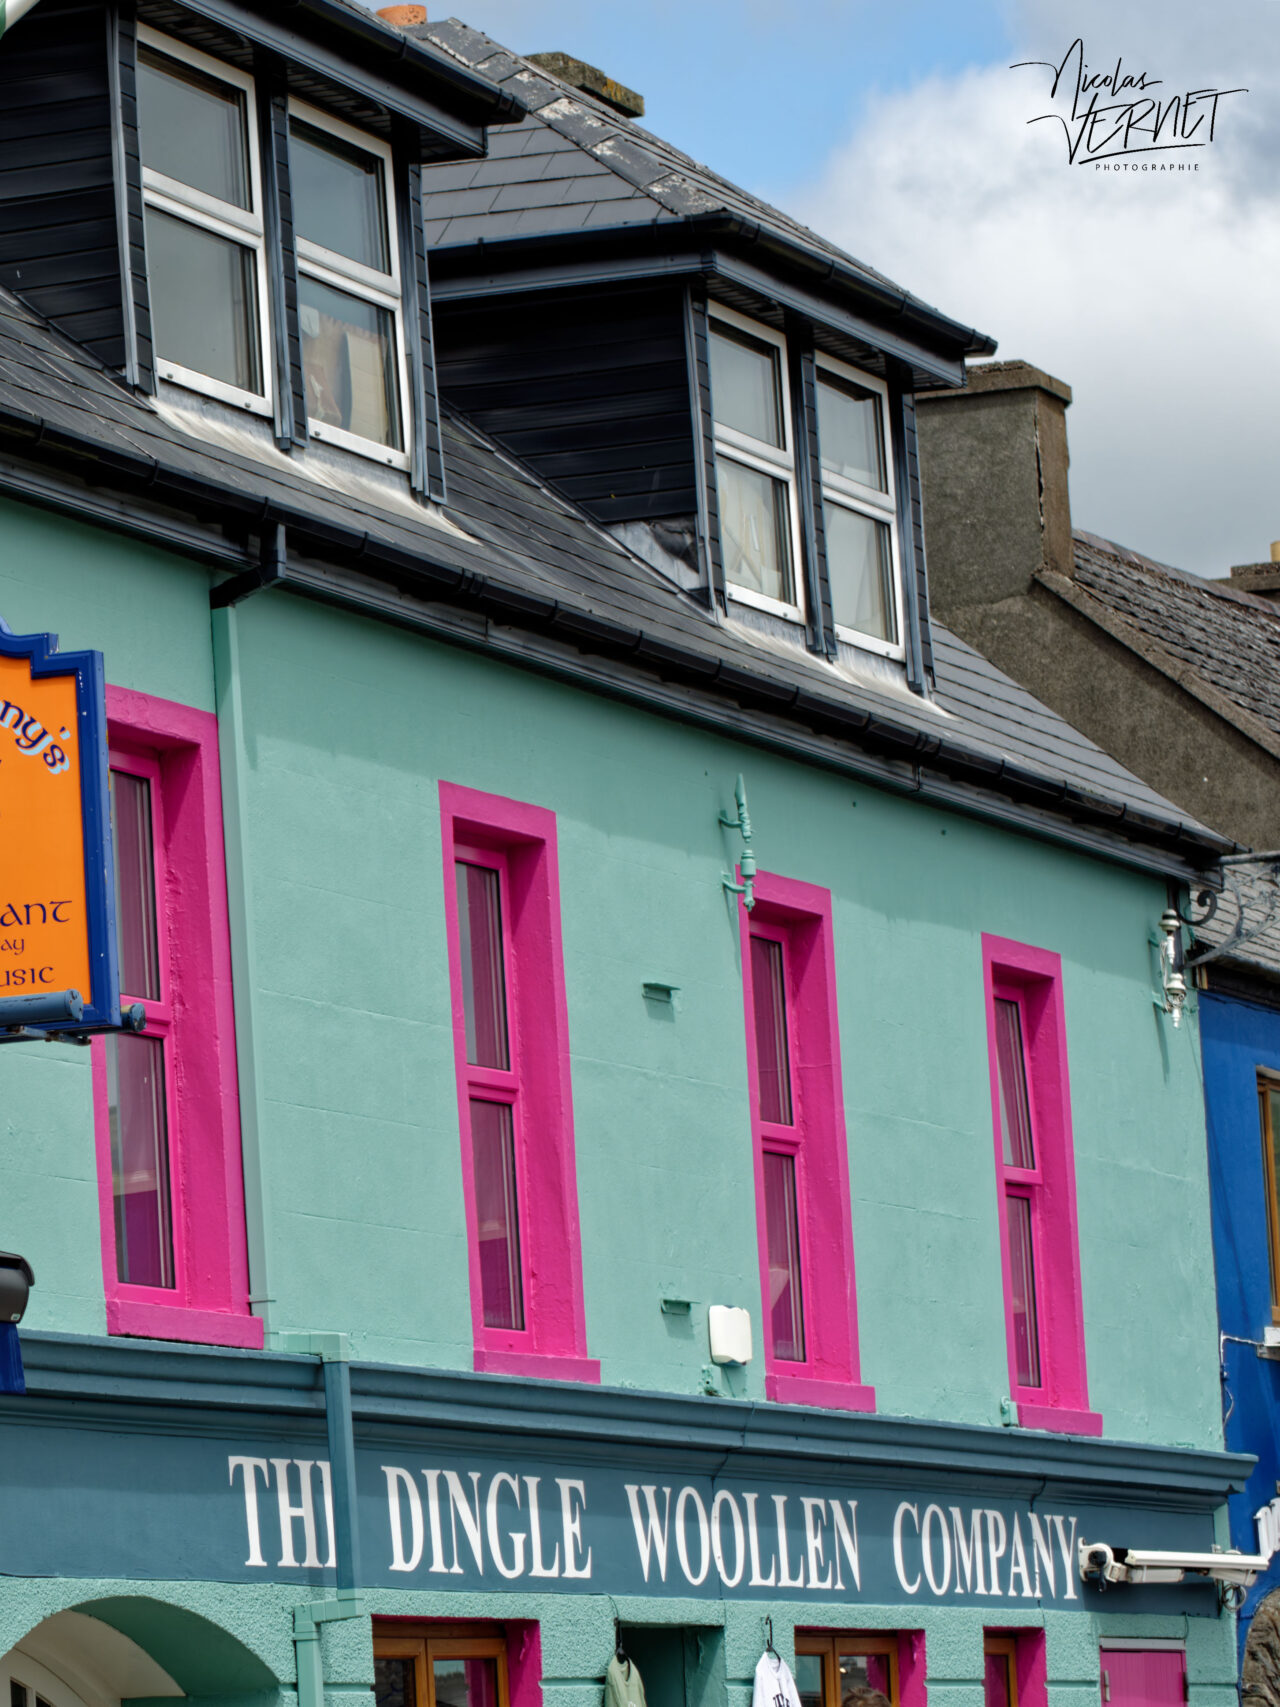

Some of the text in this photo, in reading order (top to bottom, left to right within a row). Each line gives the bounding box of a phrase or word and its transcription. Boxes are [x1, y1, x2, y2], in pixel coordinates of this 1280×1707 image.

[380, 1465, 593, 1579] DINGLE
[624, 1484, 862, 1592] WOOLLEN
[892, 1501, 1079, 1600] COMPANY
